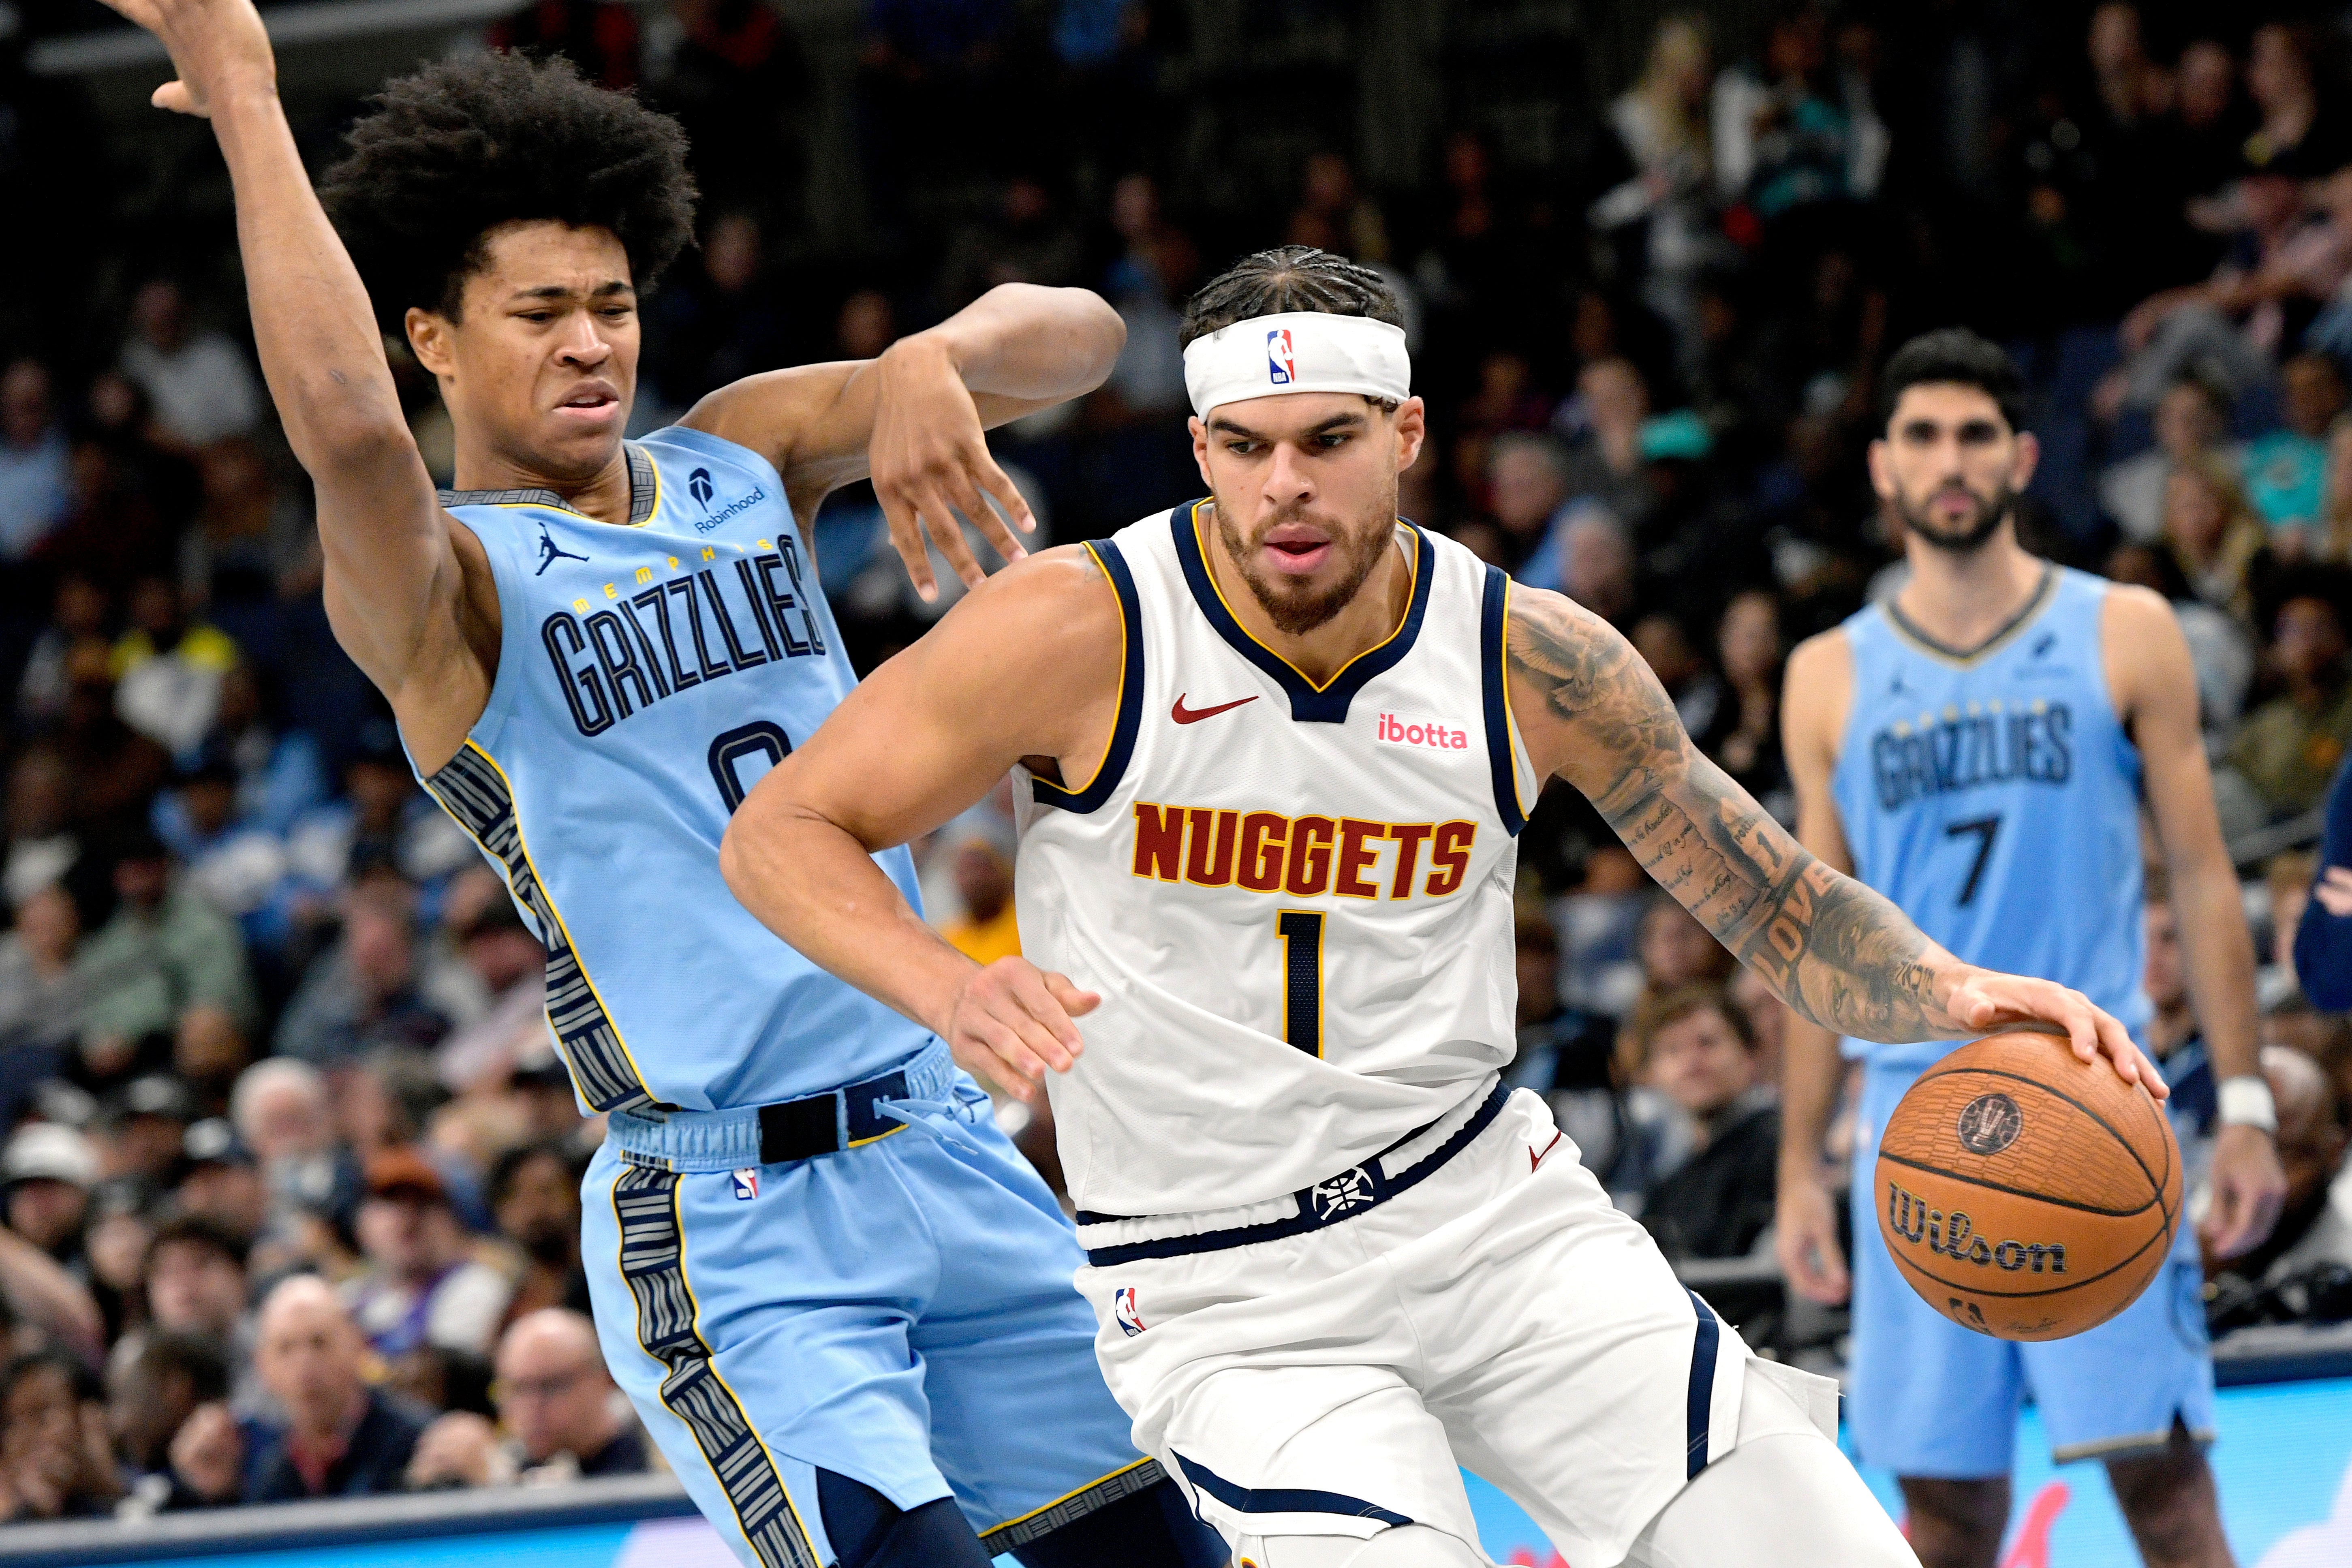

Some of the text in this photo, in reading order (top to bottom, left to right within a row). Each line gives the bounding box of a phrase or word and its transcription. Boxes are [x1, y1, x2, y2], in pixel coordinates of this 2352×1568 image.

[1273, 372, 1287, 382] NBA
[695, 486, 765, 533] Robinhood
[573, 538, 773, 615] MEMPHIS
[1379, 713, 1467, 749] ibotta
[1133, 800, 1477, 901] NUGGETS
[1946, 813, 2003, 906] 7
[1751, 859, 1843, 990] LOVE
[1275, 909, 1326, 1059] 1
[1889, 1180, 2068, 1274] Wilson
